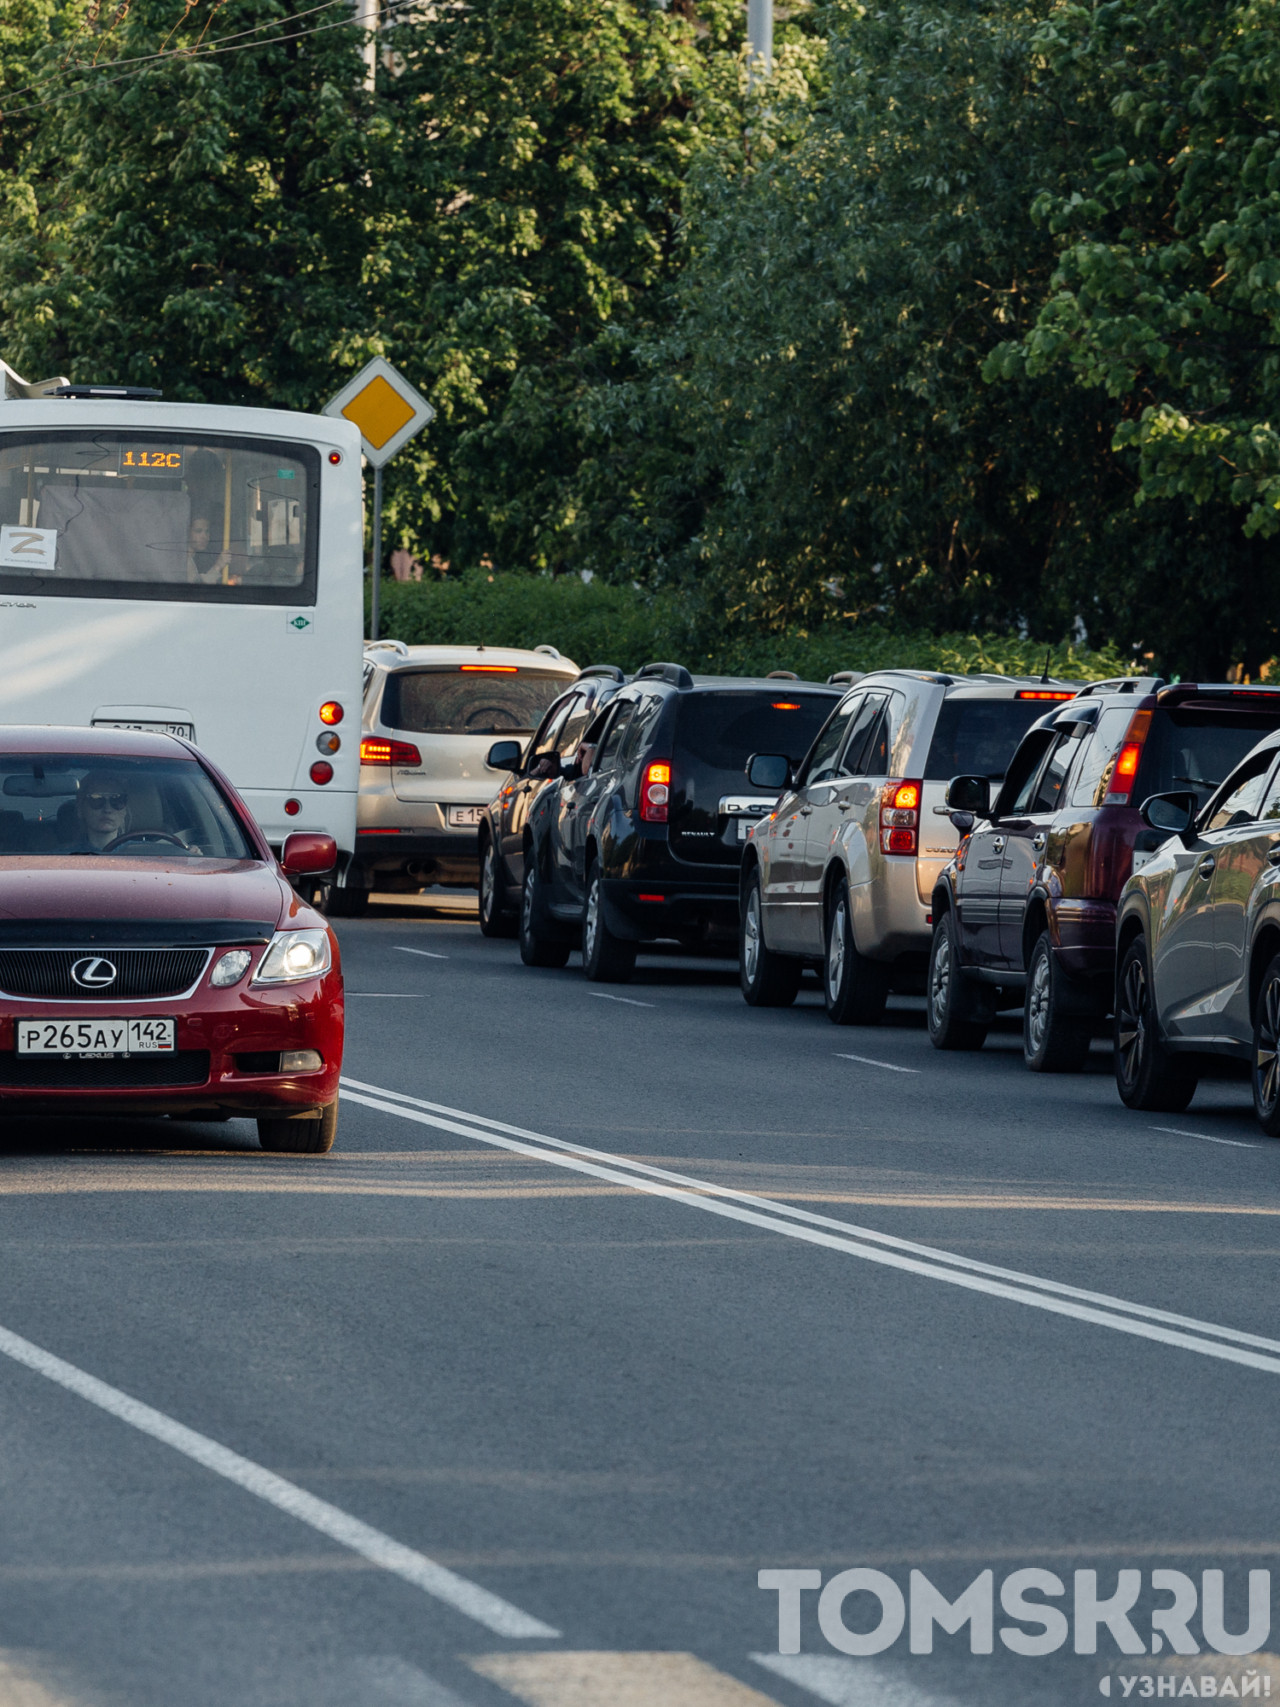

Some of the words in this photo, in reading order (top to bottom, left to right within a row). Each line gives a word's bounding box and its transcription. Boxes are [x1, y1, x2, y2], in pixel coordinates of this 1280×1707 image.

[27, 1024, 123, 1049] Р265АУ
[131, 1022, 167, 1041] 142
[138, 1041, 157, 1049] RUS
